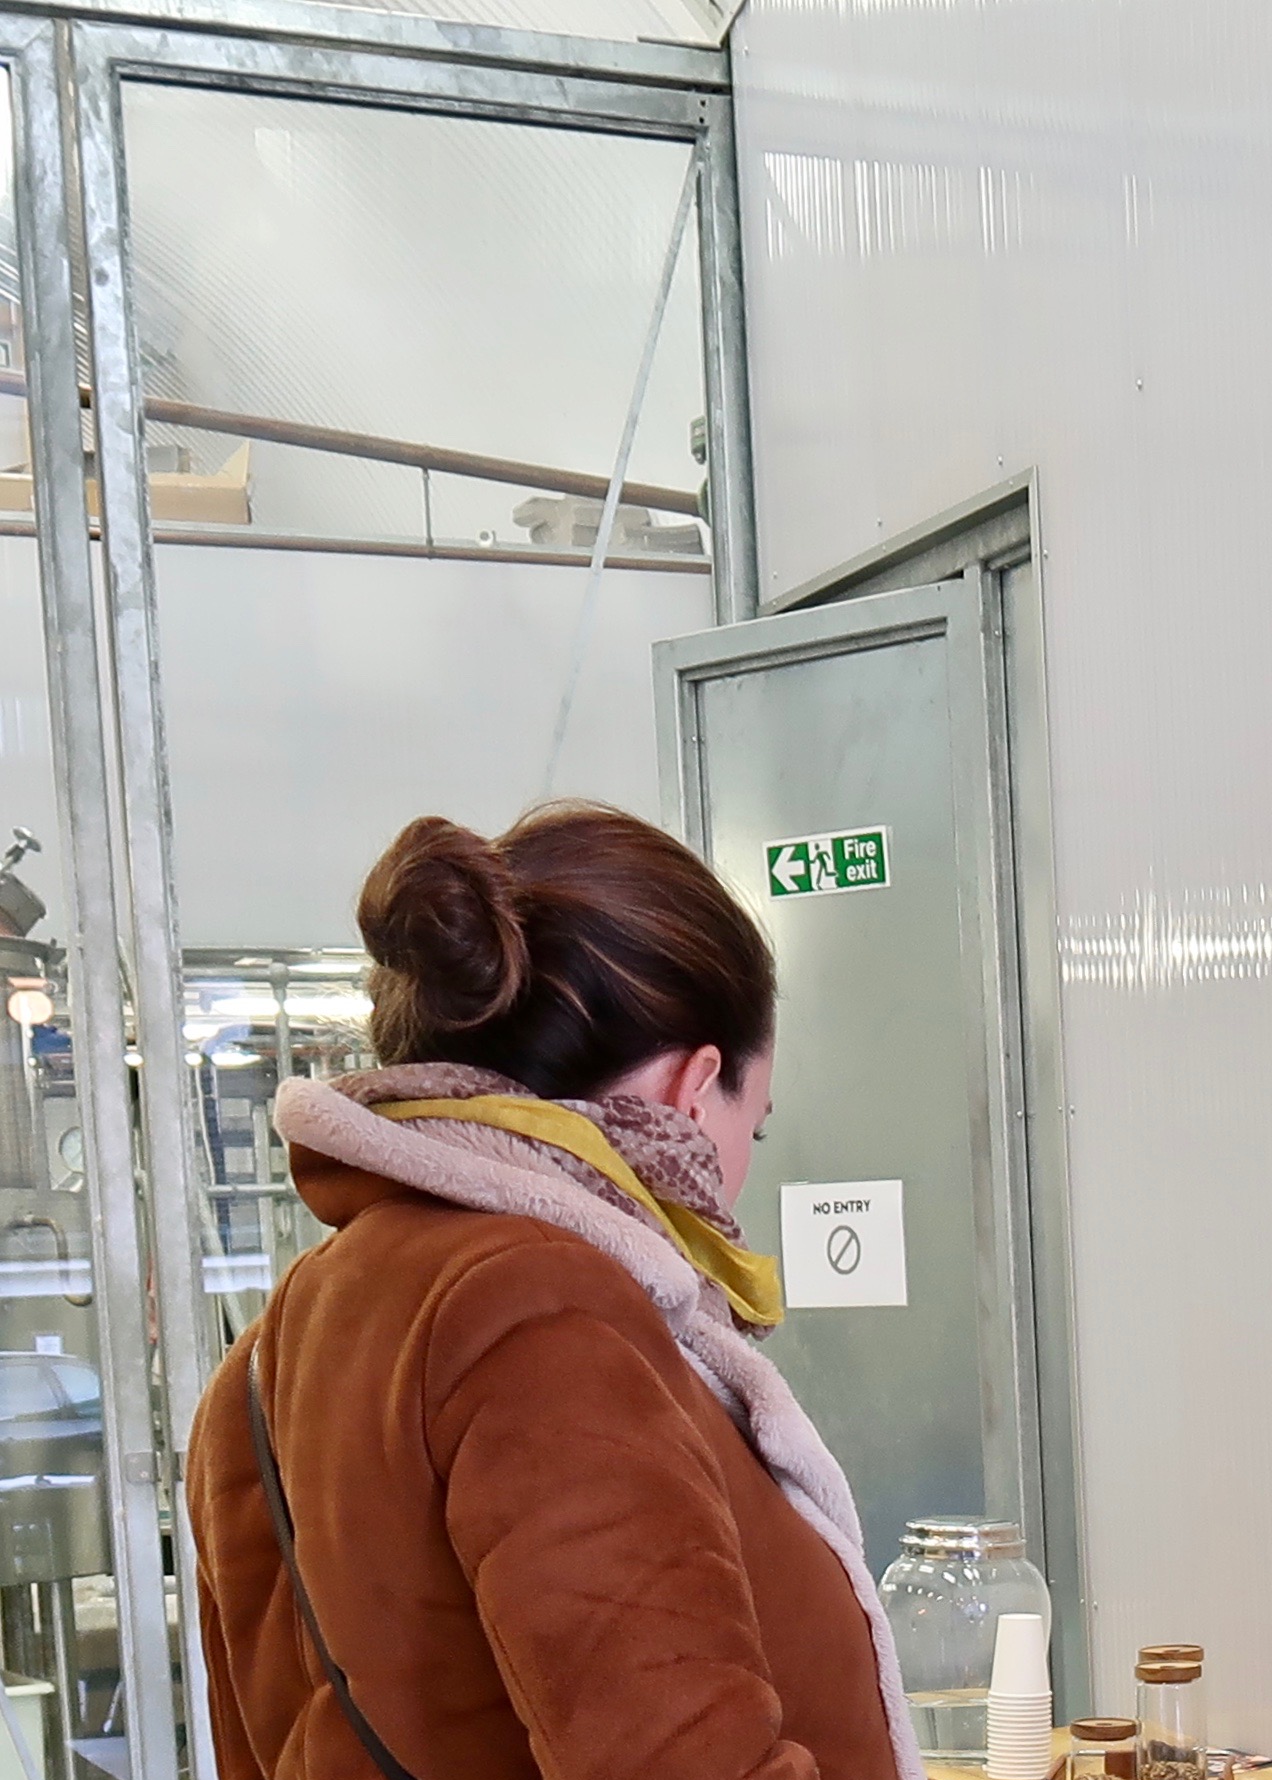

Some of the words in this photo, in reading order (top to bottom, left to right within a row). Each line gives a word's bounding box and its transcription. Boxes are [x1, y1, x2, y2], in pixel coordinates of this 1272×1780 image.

[843, 838, 877, 859] Fire
[846, 860, 878, 882] exit
[813, 1202, 831, 1215] NO
[833, 1200, 870, 1214] ENTRY
